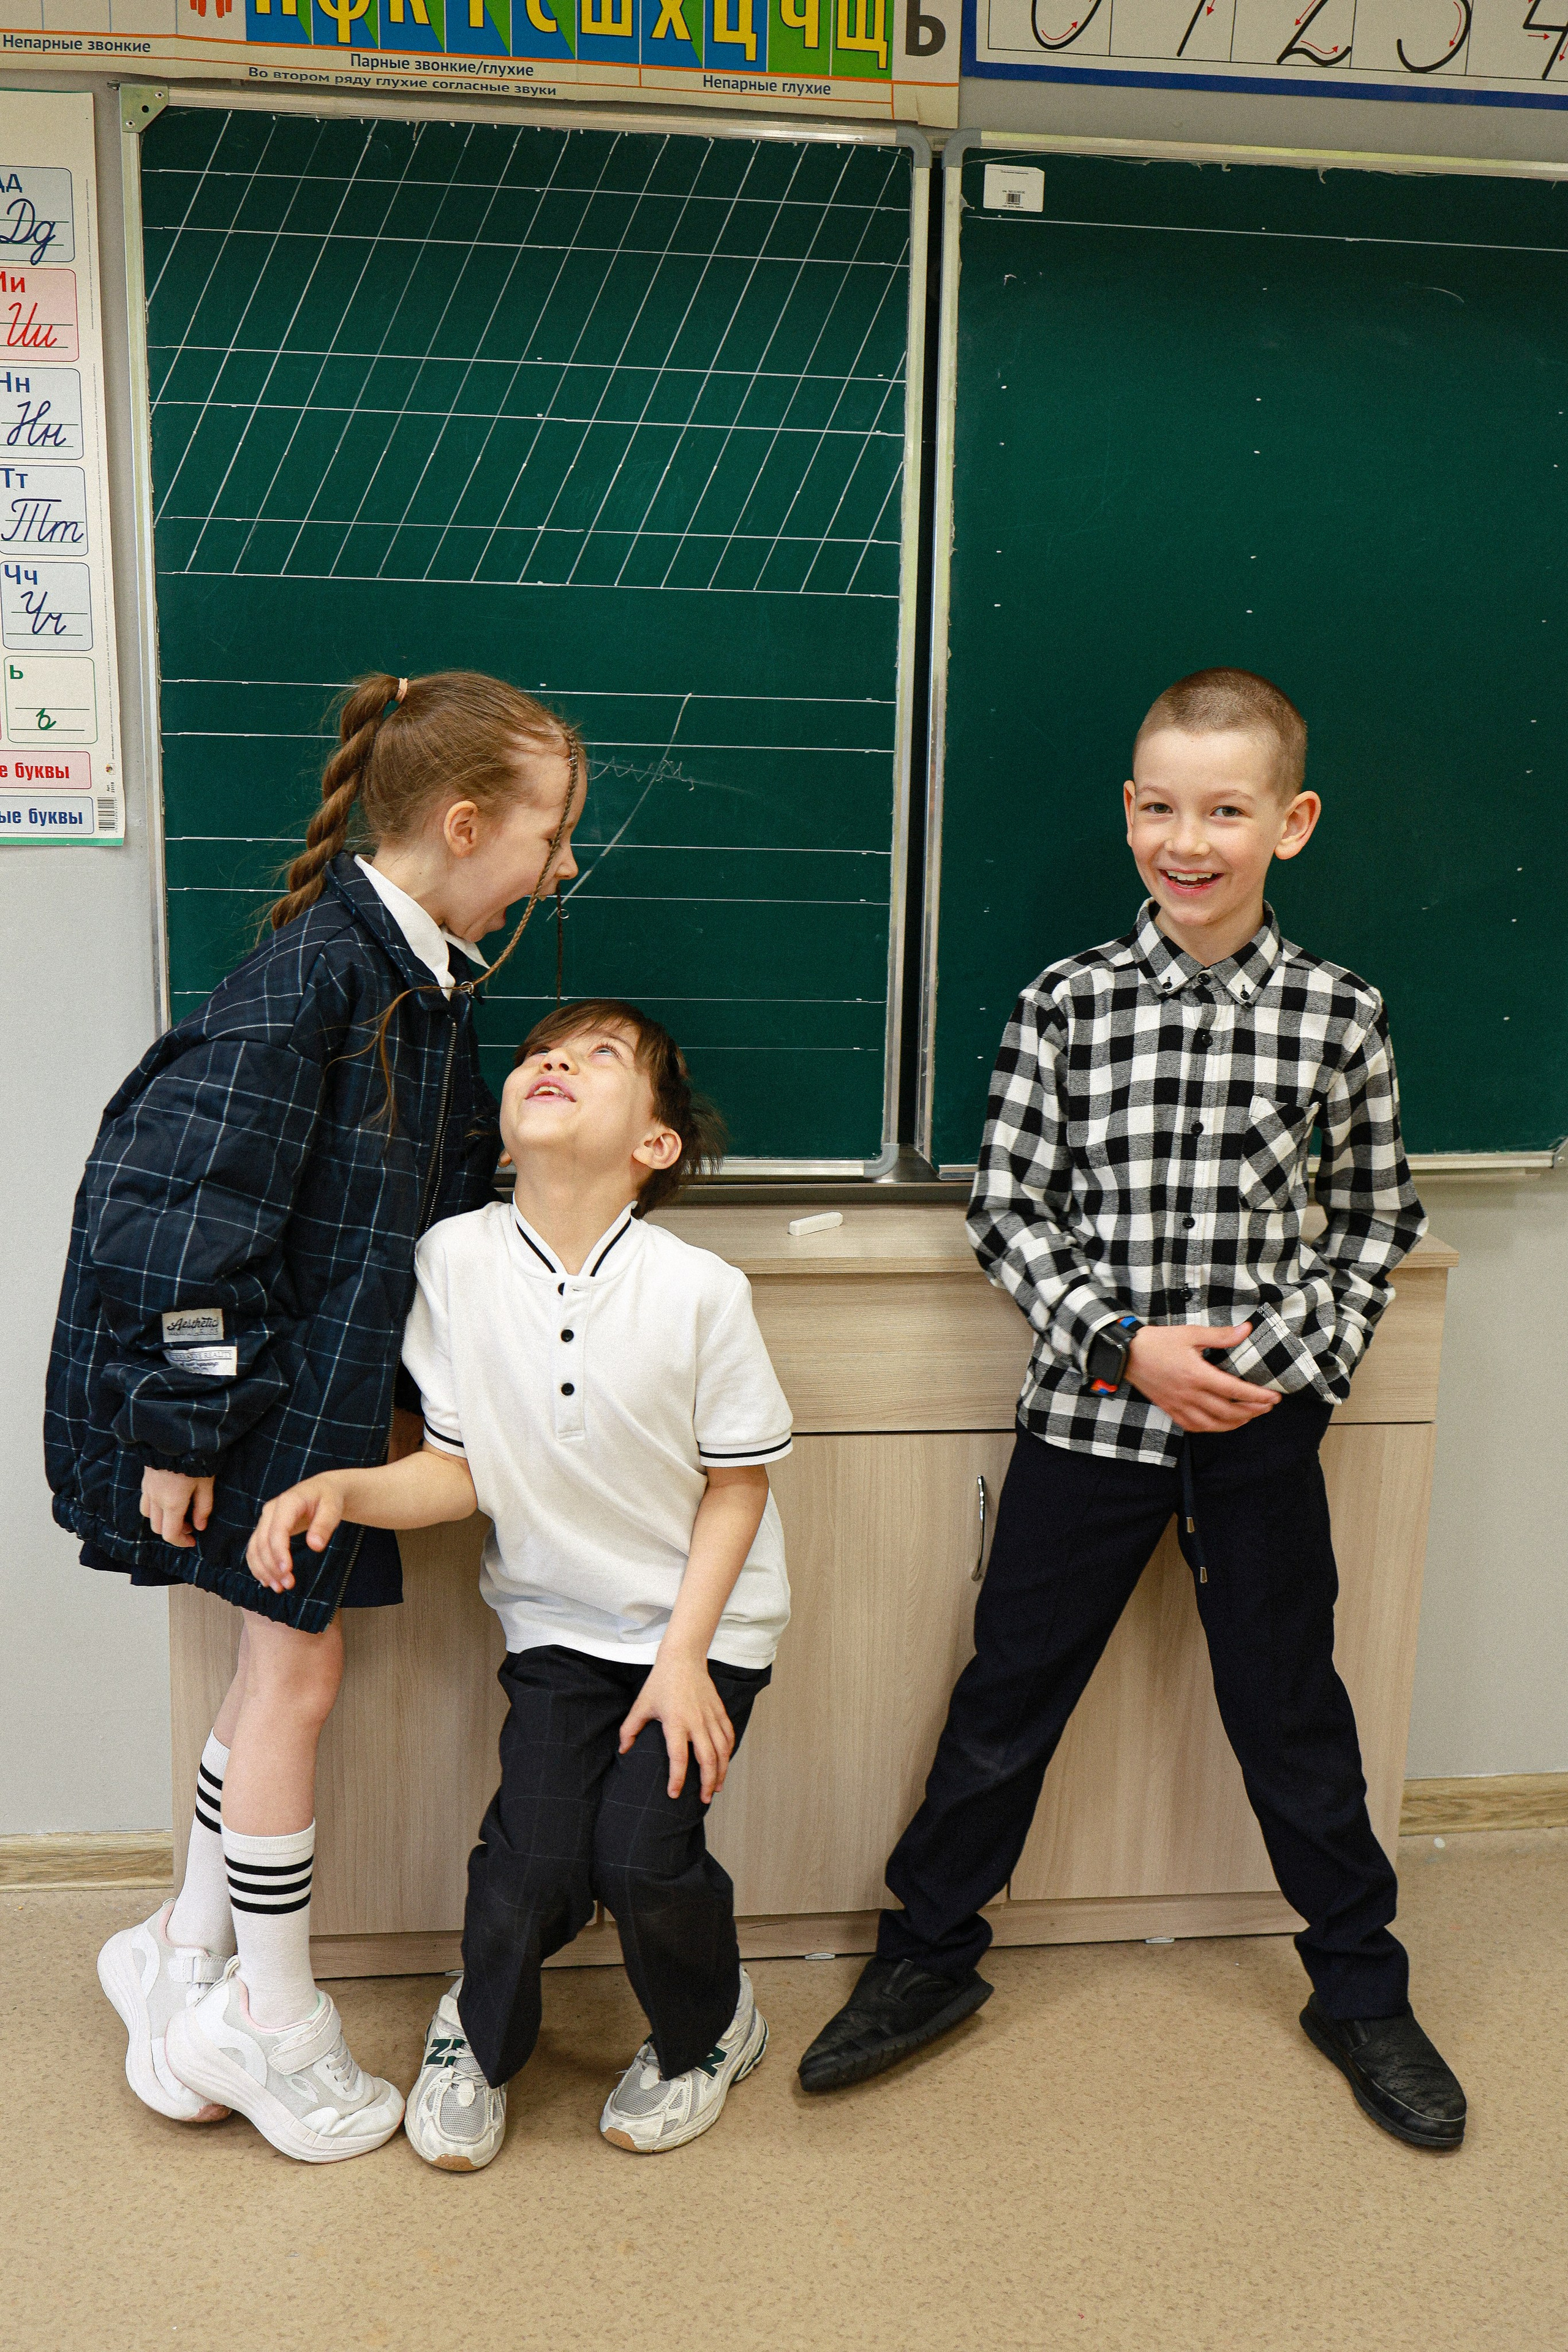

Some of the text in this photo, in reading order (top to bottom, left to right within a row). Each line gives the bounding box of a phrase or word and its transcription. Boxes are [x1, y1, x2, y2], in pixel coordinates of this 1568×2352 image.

[2, 34, 151, 53] Непарные звонкие
[350, 53, 535, 78] Парные звонкие/глухие
[249, 67, 557, 97] Во втором ряду глухие согласные звуки
[703, 74, 832, 97] Непарные глухие
[4, 564, 39, 586] Чч
[15, 762, 70, 781] буквы
[28, 808, 83, 827] буквы
